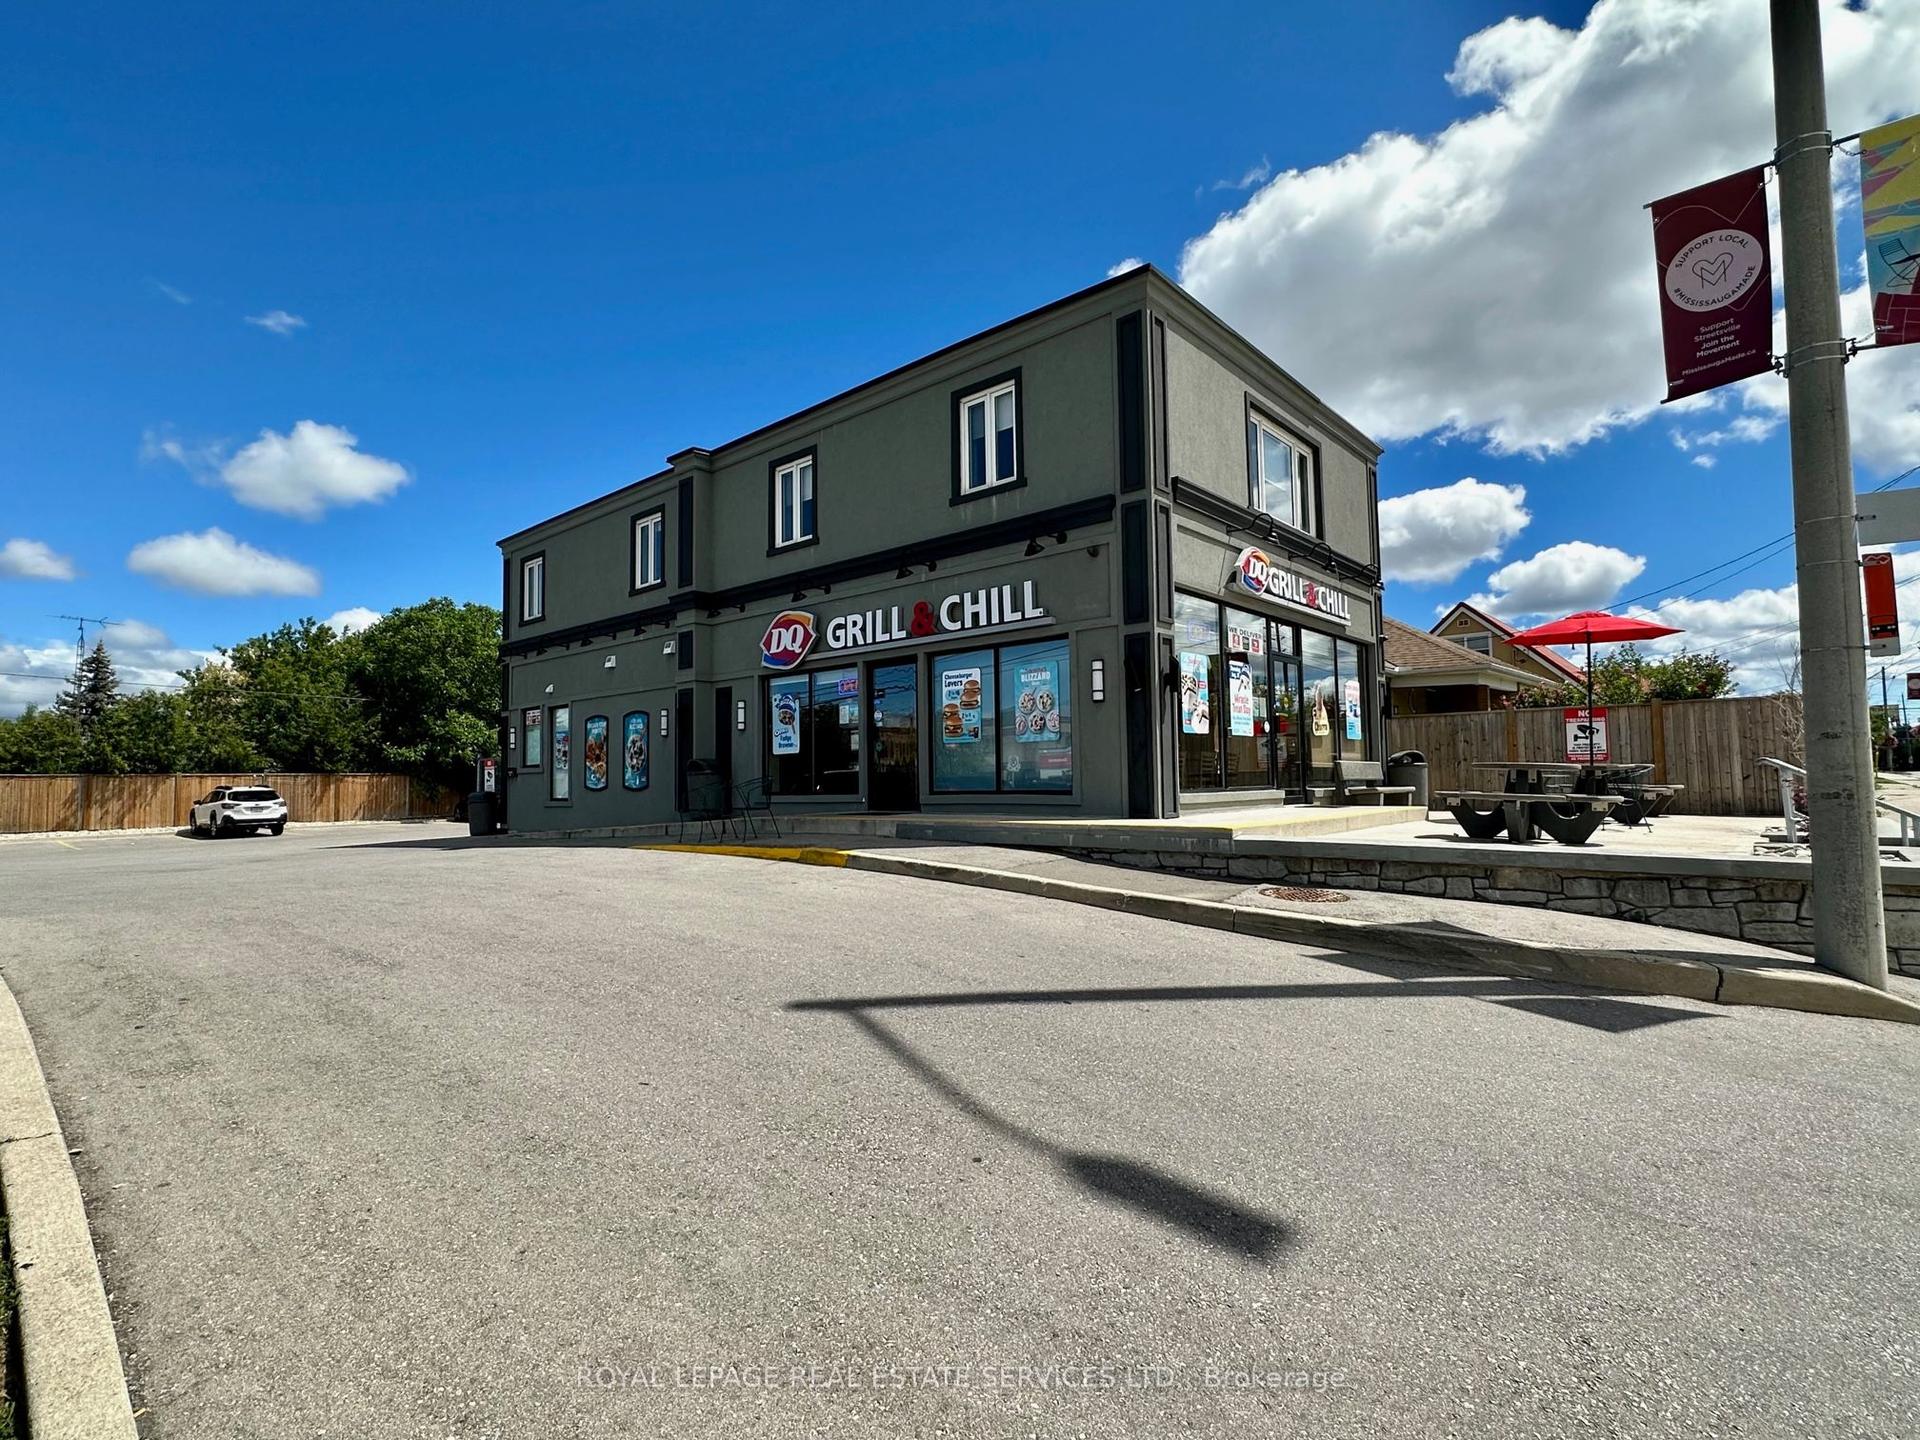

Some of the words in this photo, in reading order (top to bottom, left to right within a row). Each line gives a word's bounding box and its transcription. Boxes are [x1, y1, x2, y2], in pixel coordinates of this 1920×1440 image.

[1675, 236, 1714, 269] SUPPORT
[1719, 234, 1749, 249] LOCAL
[1674, 265, 1756, 307] #MISSISSAUGAMADE
[1694, 324, 1741, 342] Streetsville
[1700, 318, 1734, 333] Support
[1696, 340, 1740, 358] Movement
[1701, 340, 1719, 350] Join
[1720, 335, 1735, 344] the
[1248, 557, 1268, 585] DQ
[1268, 567, 1307, 605] GRILL
[1305, 581, 1318, 608] &
[1318, 587, 1351, 620] CHILL
[769, 624, 805, 654] DQ
[826, 606, 907, 649] GRILL
[910, 600, 940, 637] &
[939, 580, 1044, 631] CHILL
[1228, 625, 1238, 634] WE
[1239, 628, 1262, 639] DELIVER
[1020, 671, 1051, 683] BLIZZARD
